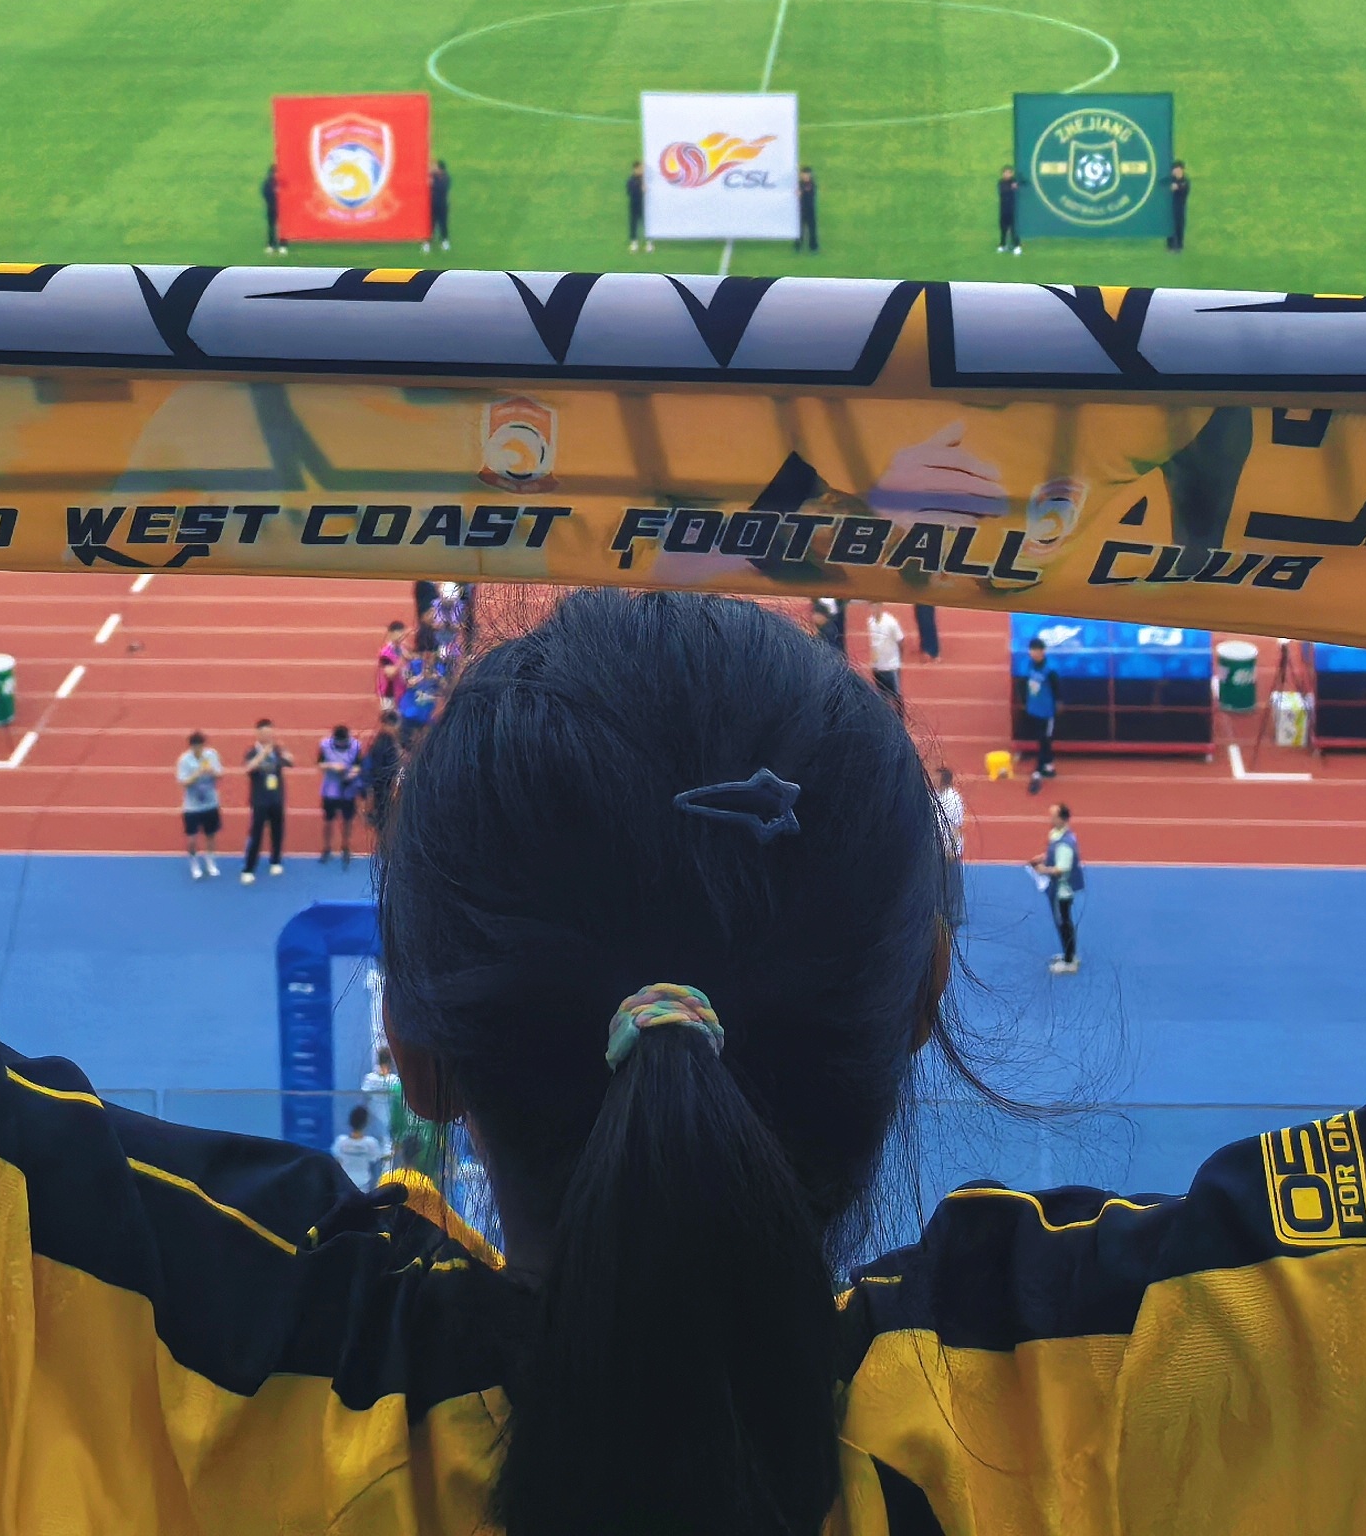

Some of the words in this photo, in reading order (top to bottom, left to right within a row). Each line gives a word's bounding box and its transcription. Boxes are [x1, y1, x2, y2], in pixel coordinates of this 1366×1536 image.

[723, 168, 776, 189] CSL
[65, 505, 280, 546] WEST
[300, 505, 573, 548] COAST
[609, 507, 1044, 583] FOOTBALL
[1087, 540, 1325, 591] CLUB
[1336, 1164, 1363, 1223] FOR
